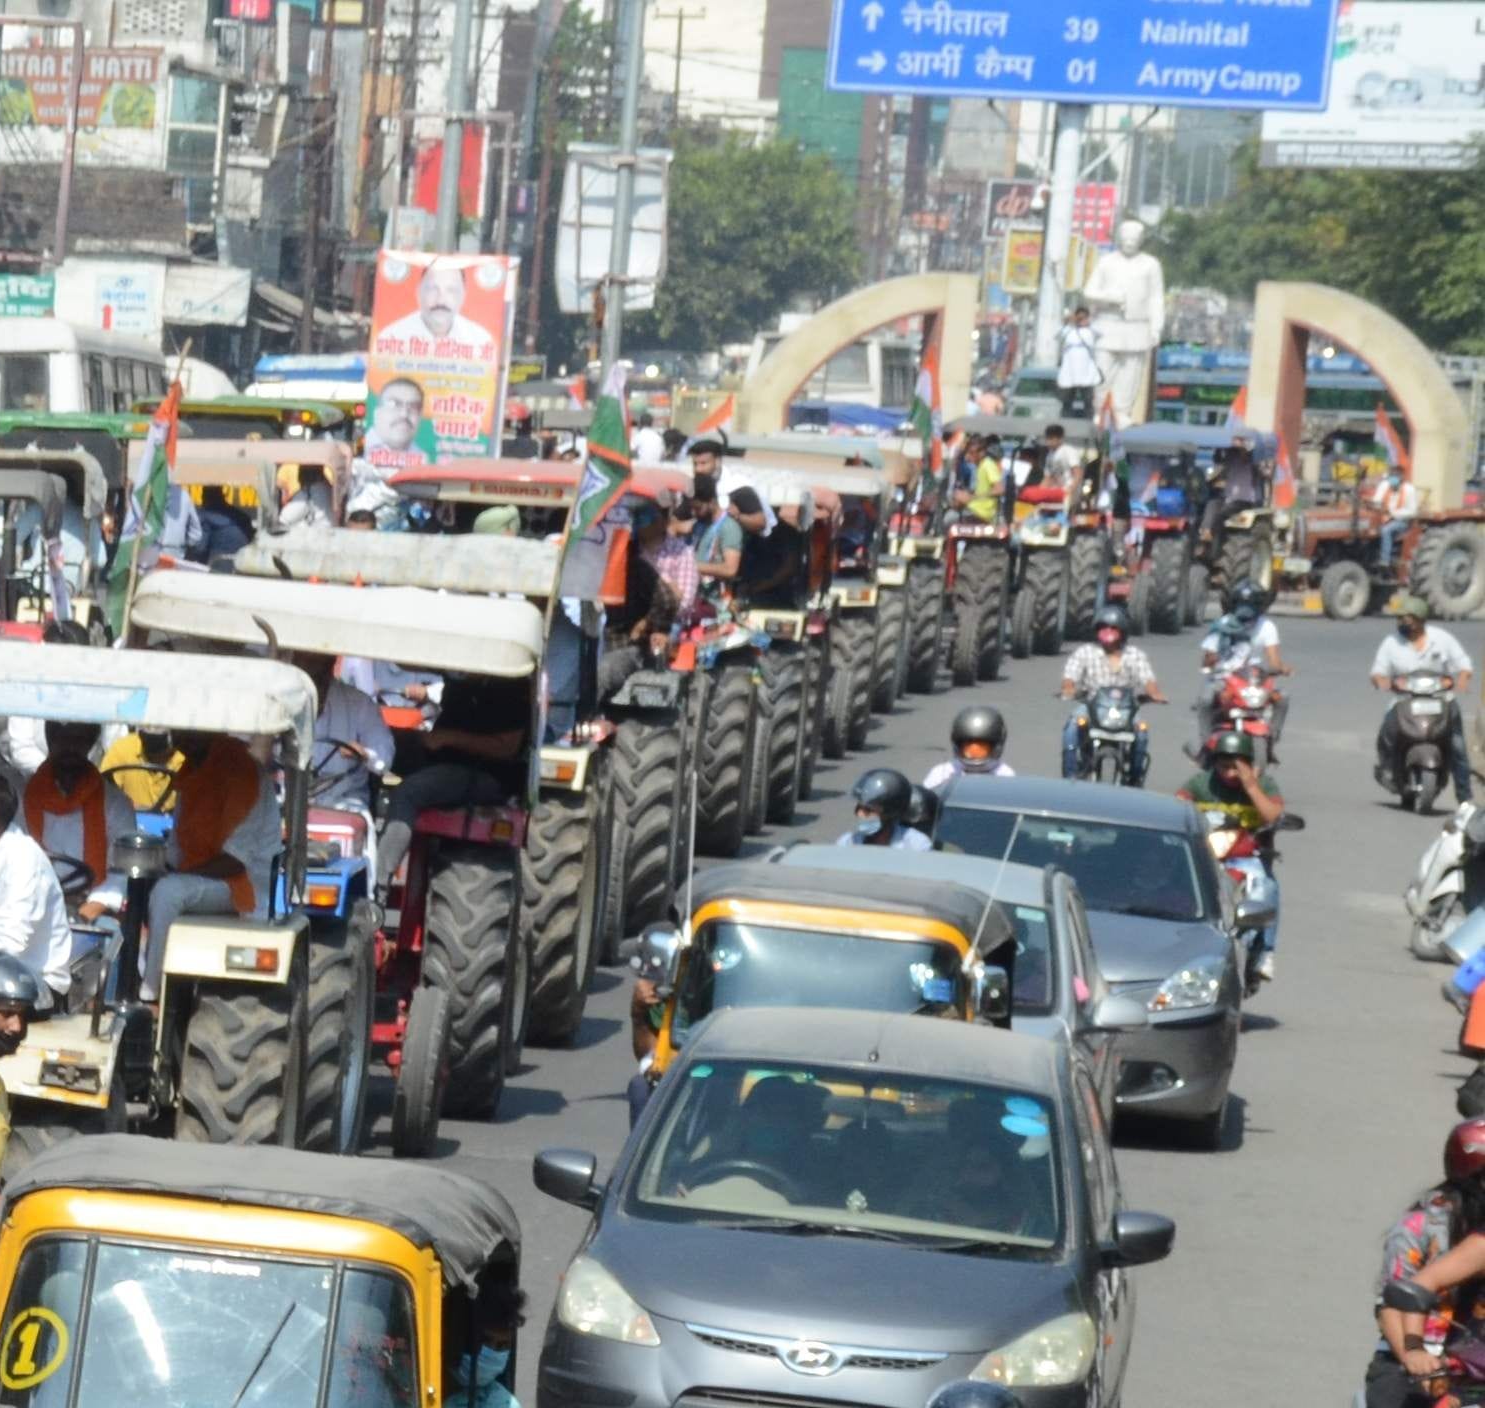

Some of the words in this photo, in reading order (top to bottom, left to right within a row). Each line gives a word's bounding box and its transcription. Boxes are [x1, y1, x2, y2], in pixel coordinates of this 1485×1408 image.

[901, 1, 1008, 37] नैनीताल
[1063, 17, 1100, 42] 39
[1140, 20, 1249, 47] Nainital
[90, 55, 153, 80] HATTI
[896, 45, 961, 79] आर्मी
[975, 49, 1034, 81] कैम्प
[1066, 60, 1097, 83] 01
[11, 1321, 41, 1376] 1
